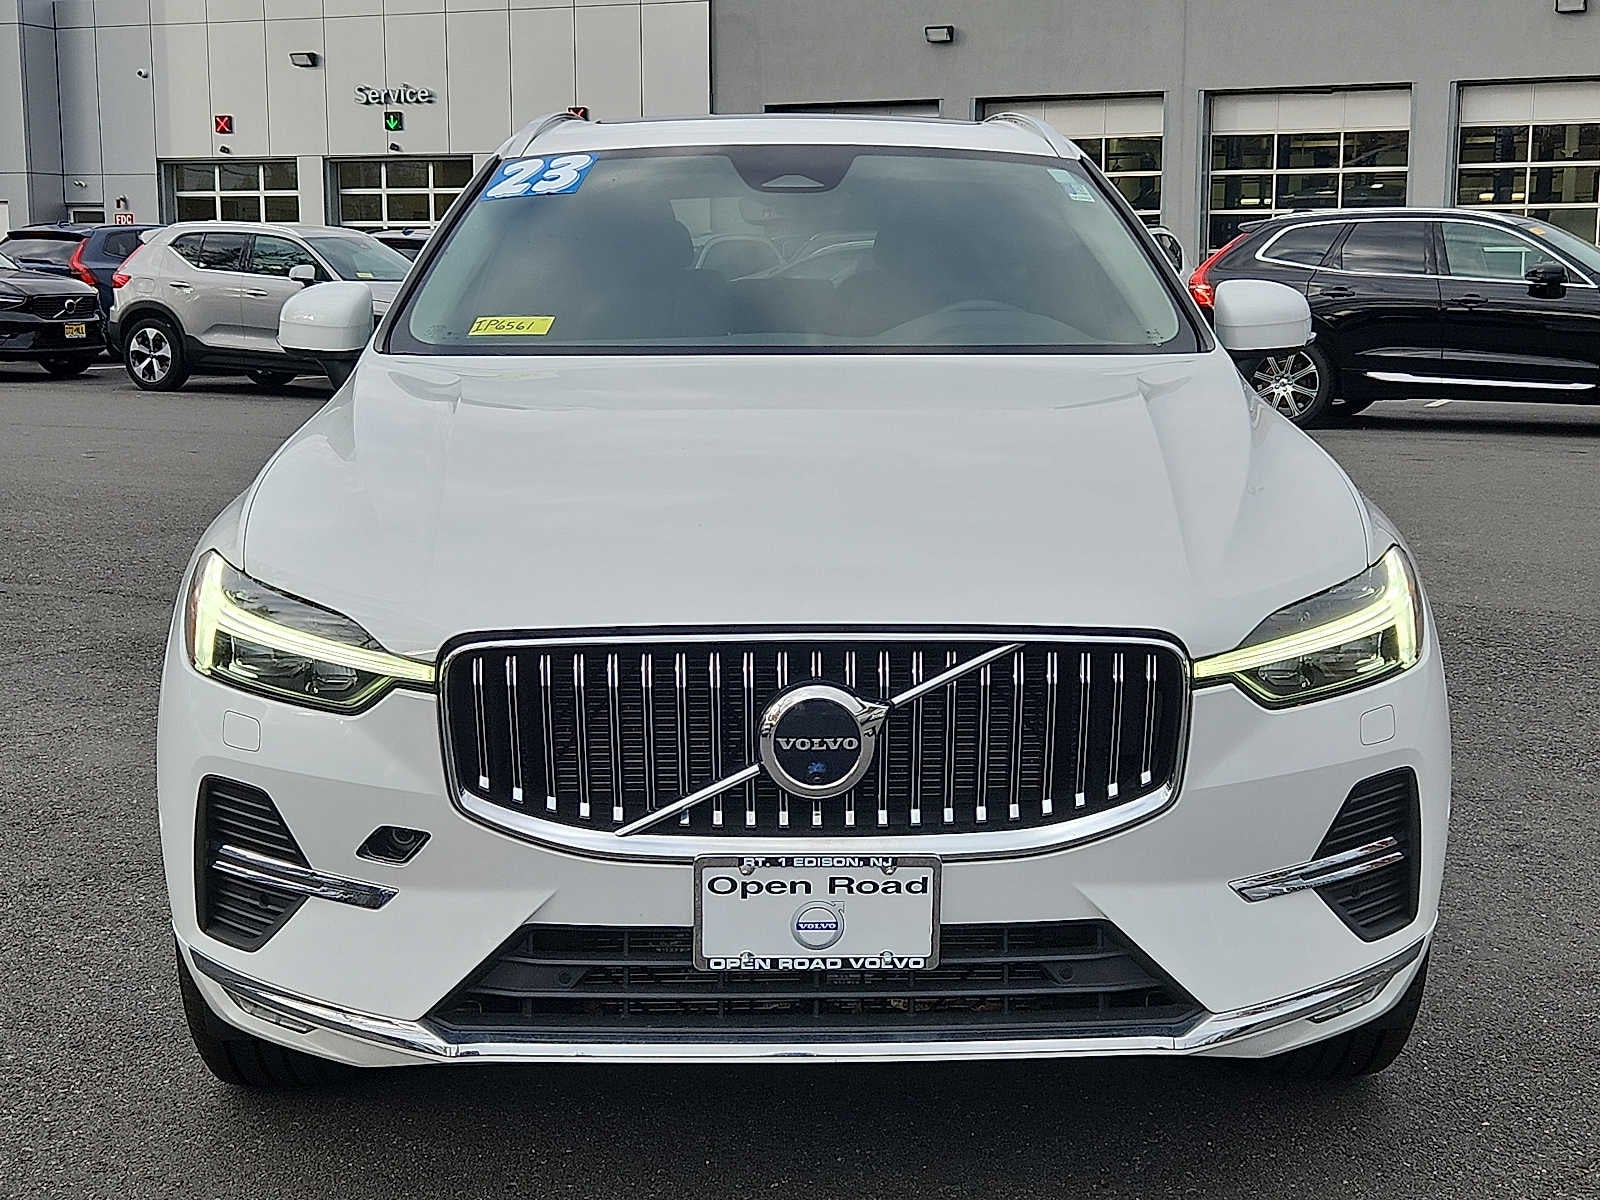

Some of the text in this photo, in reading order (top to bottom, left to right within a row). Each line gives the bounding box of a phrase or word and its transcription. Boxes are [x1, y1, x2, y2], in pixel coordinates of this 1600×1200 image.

[354, 83, 431, 104] Service
[487, 155, 592, 198] 23
[116, 214, 132, 224] FDC
[776, 738, 859, 750] VOLVO
[743, 857, 893, 867] RT. 1 EDISON, NJ
[707, 876, 929, 899] Open Road
[709, 957, 925, 970] OPEN ROAD VOLVO
